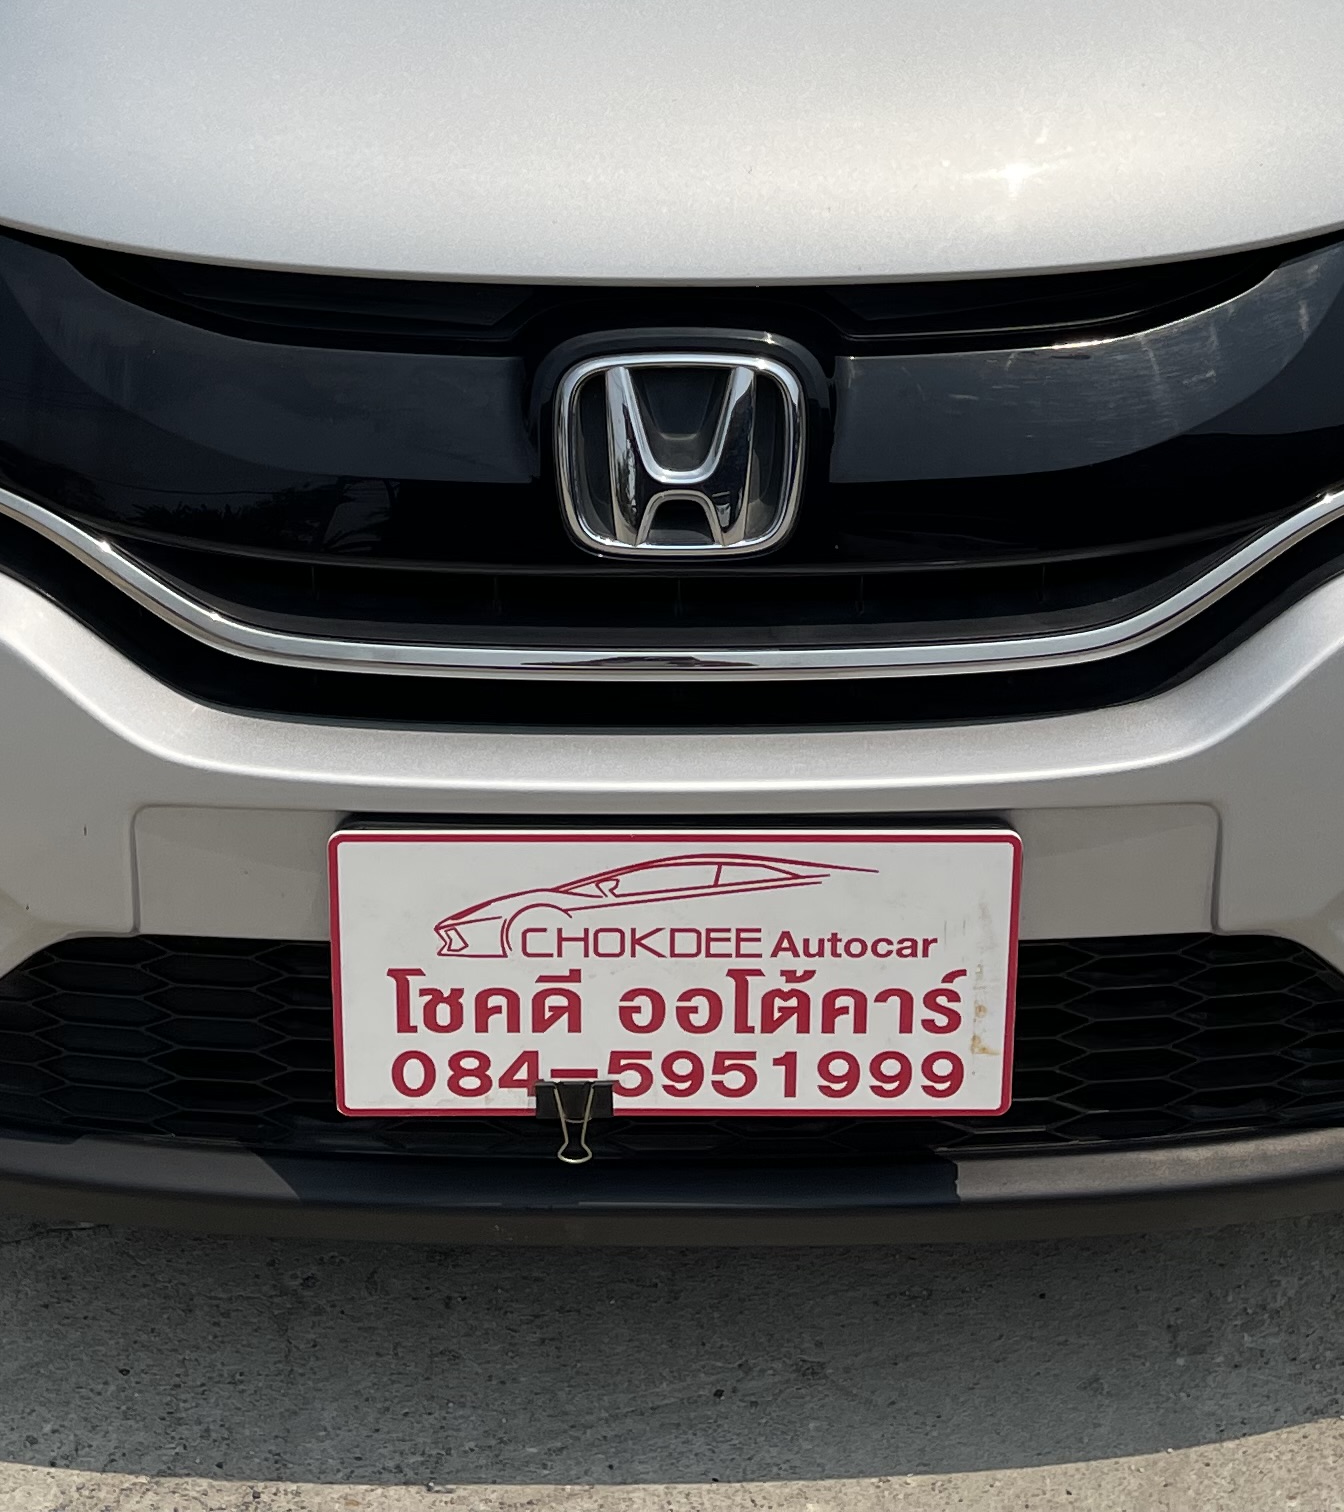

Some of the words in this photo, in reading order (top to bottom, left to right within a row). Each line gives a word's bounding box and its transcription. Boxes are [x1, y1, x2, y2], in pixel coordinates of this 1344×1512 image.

[521, 927, 762, 959] CHOKDEE
[771, 930, 938, 959] Autocar
[386, 967, 582, 1034] โชคดี
[618, 967, 967, 1035] ออโต้คาร์
[391, 1049, 965, 1099] 084-5951999
